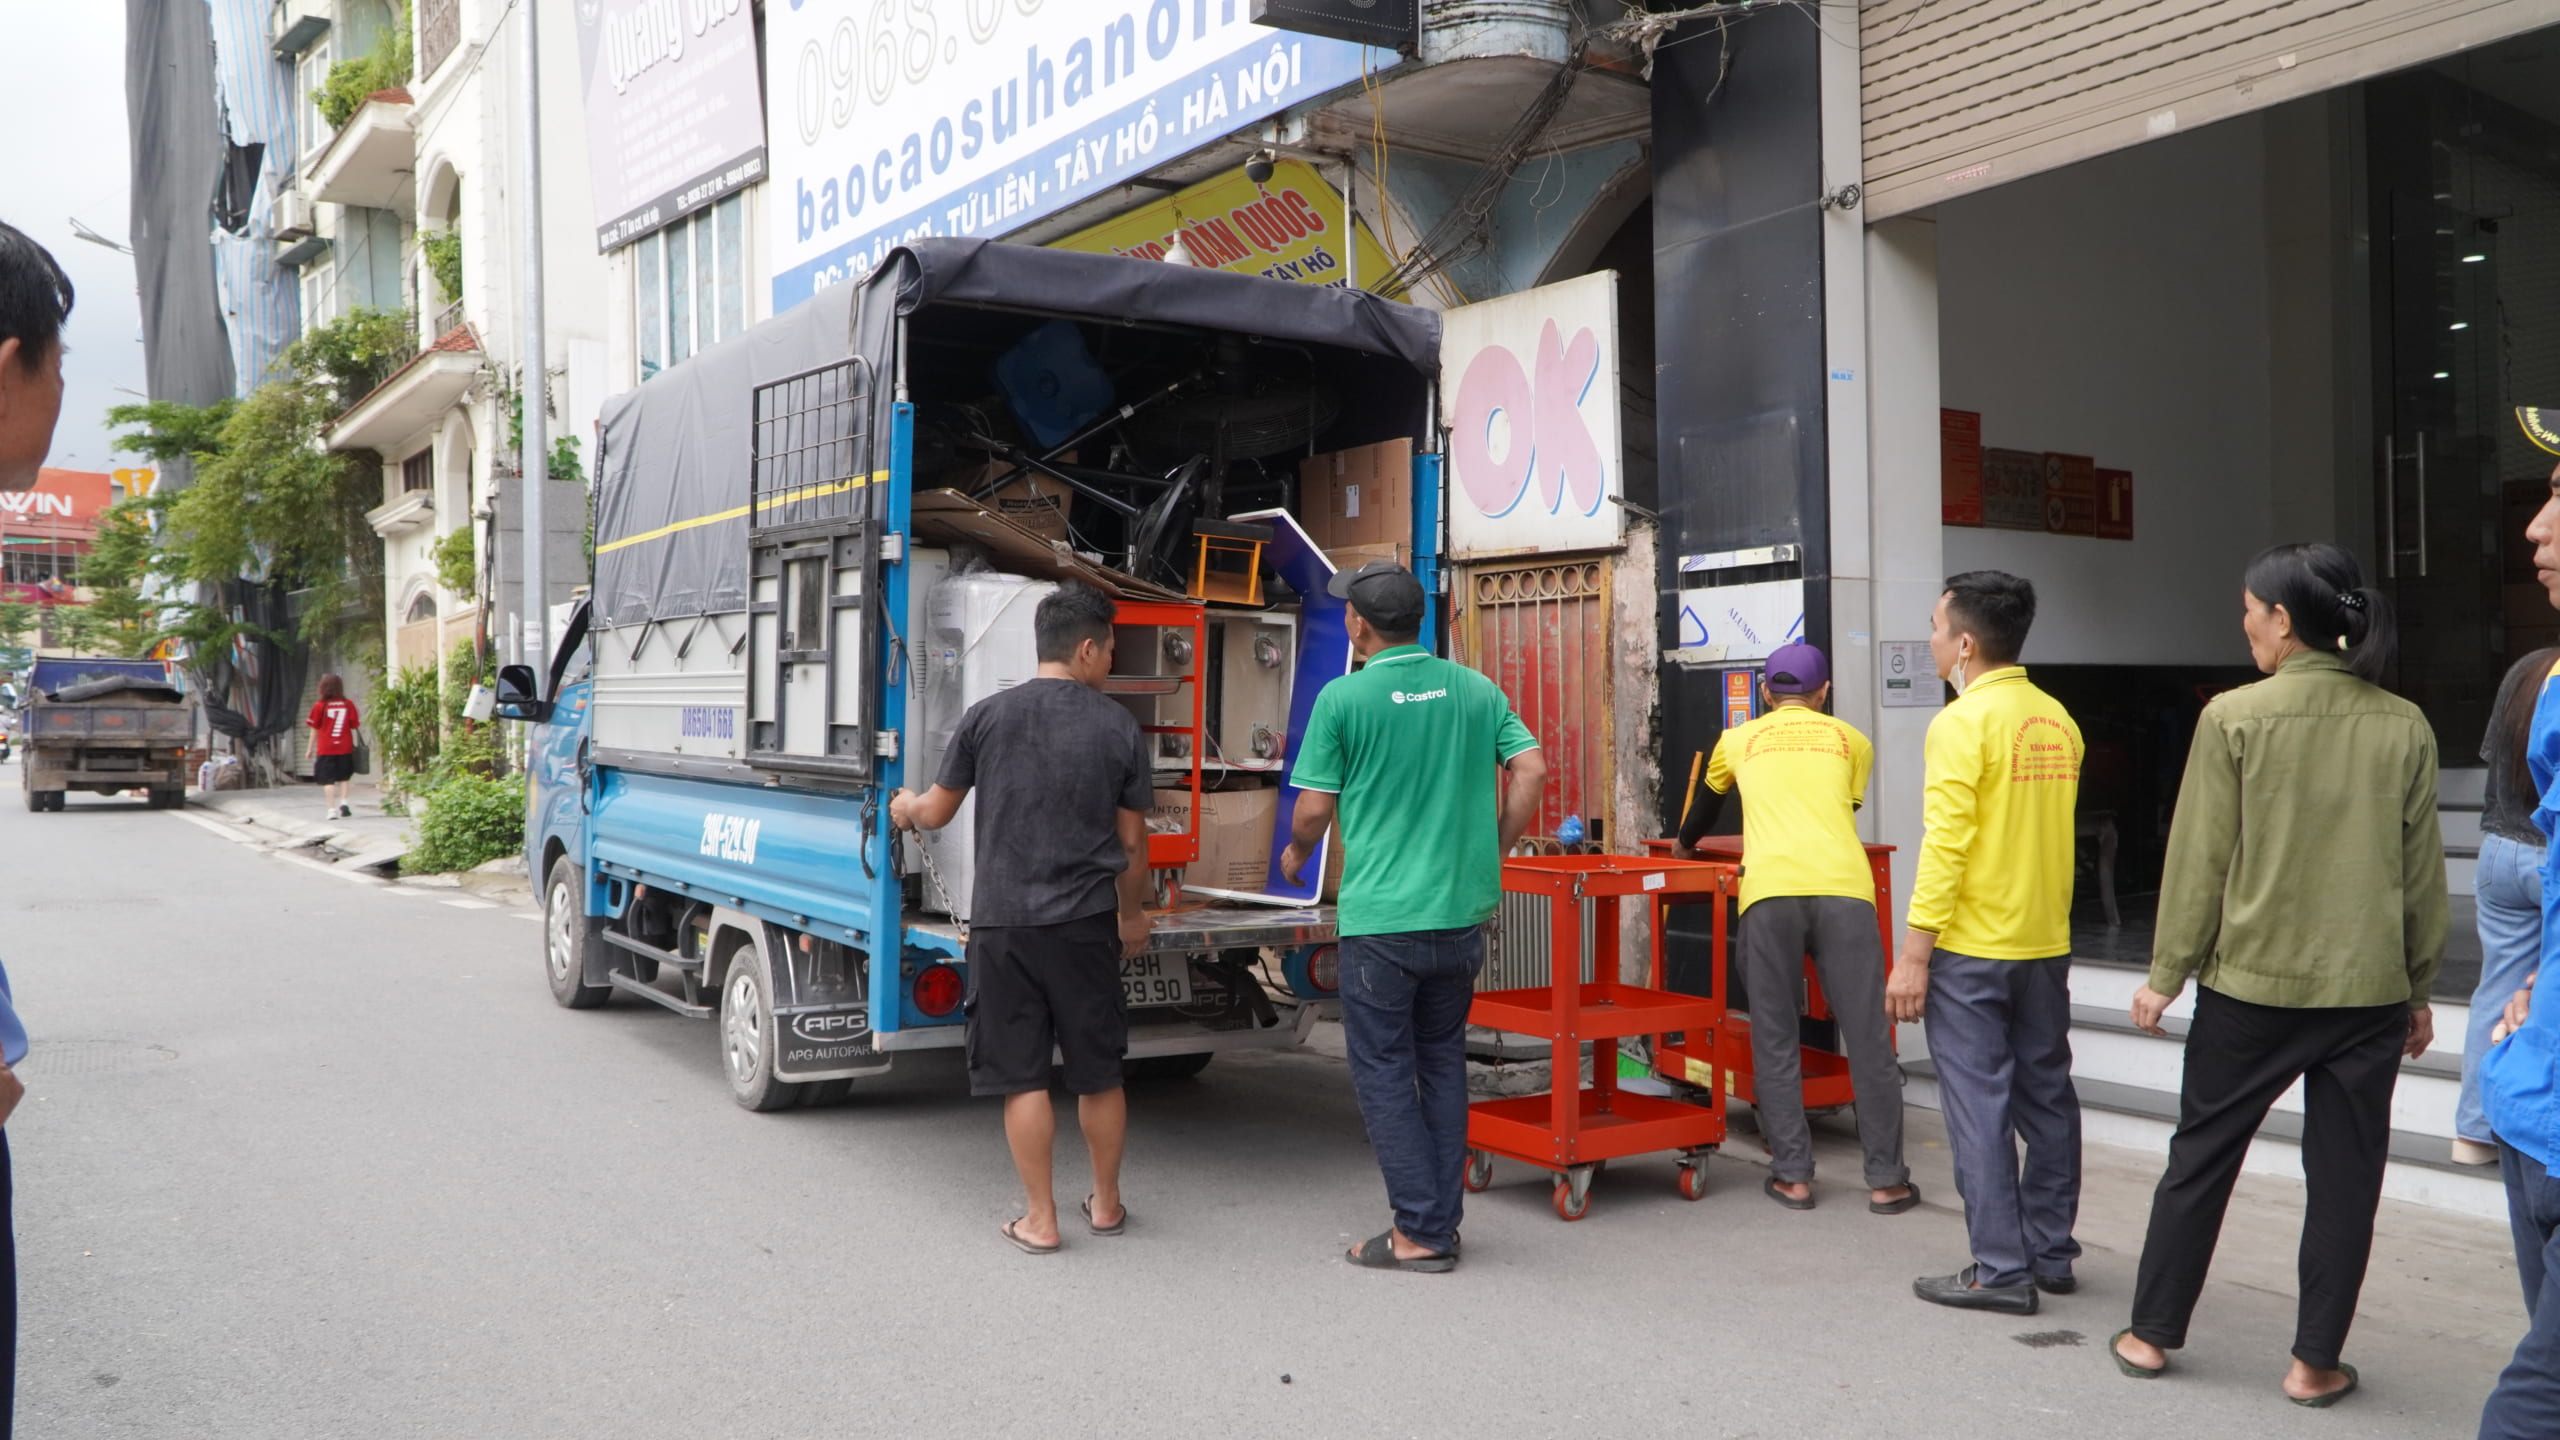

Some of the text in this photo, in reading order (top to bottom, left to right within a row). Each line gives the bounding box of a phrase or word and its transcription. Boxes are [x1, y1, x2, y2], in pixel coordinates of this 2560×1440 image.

[982, 171, 1036, 229] LIÊN
[1055, 134, 1109, 192] TÂY
[1116, 99, 1159, 167] HỒ
[1182, 72, 1230, 136] HÀ
[1237, 42, 1302, 111] NỘI
[1231, 183, 1326, 254] QUỐC
[1301, 246, 1336, 274] HỒ
[1454, 317, 1603, 518] OK
[1406, 688, 1447, 702] Castrol
[327, 708, 348, 737] 7
[804, 1013, 866, 1033] APG
[786, 1043, 884, 1063] APG AUTOPART
